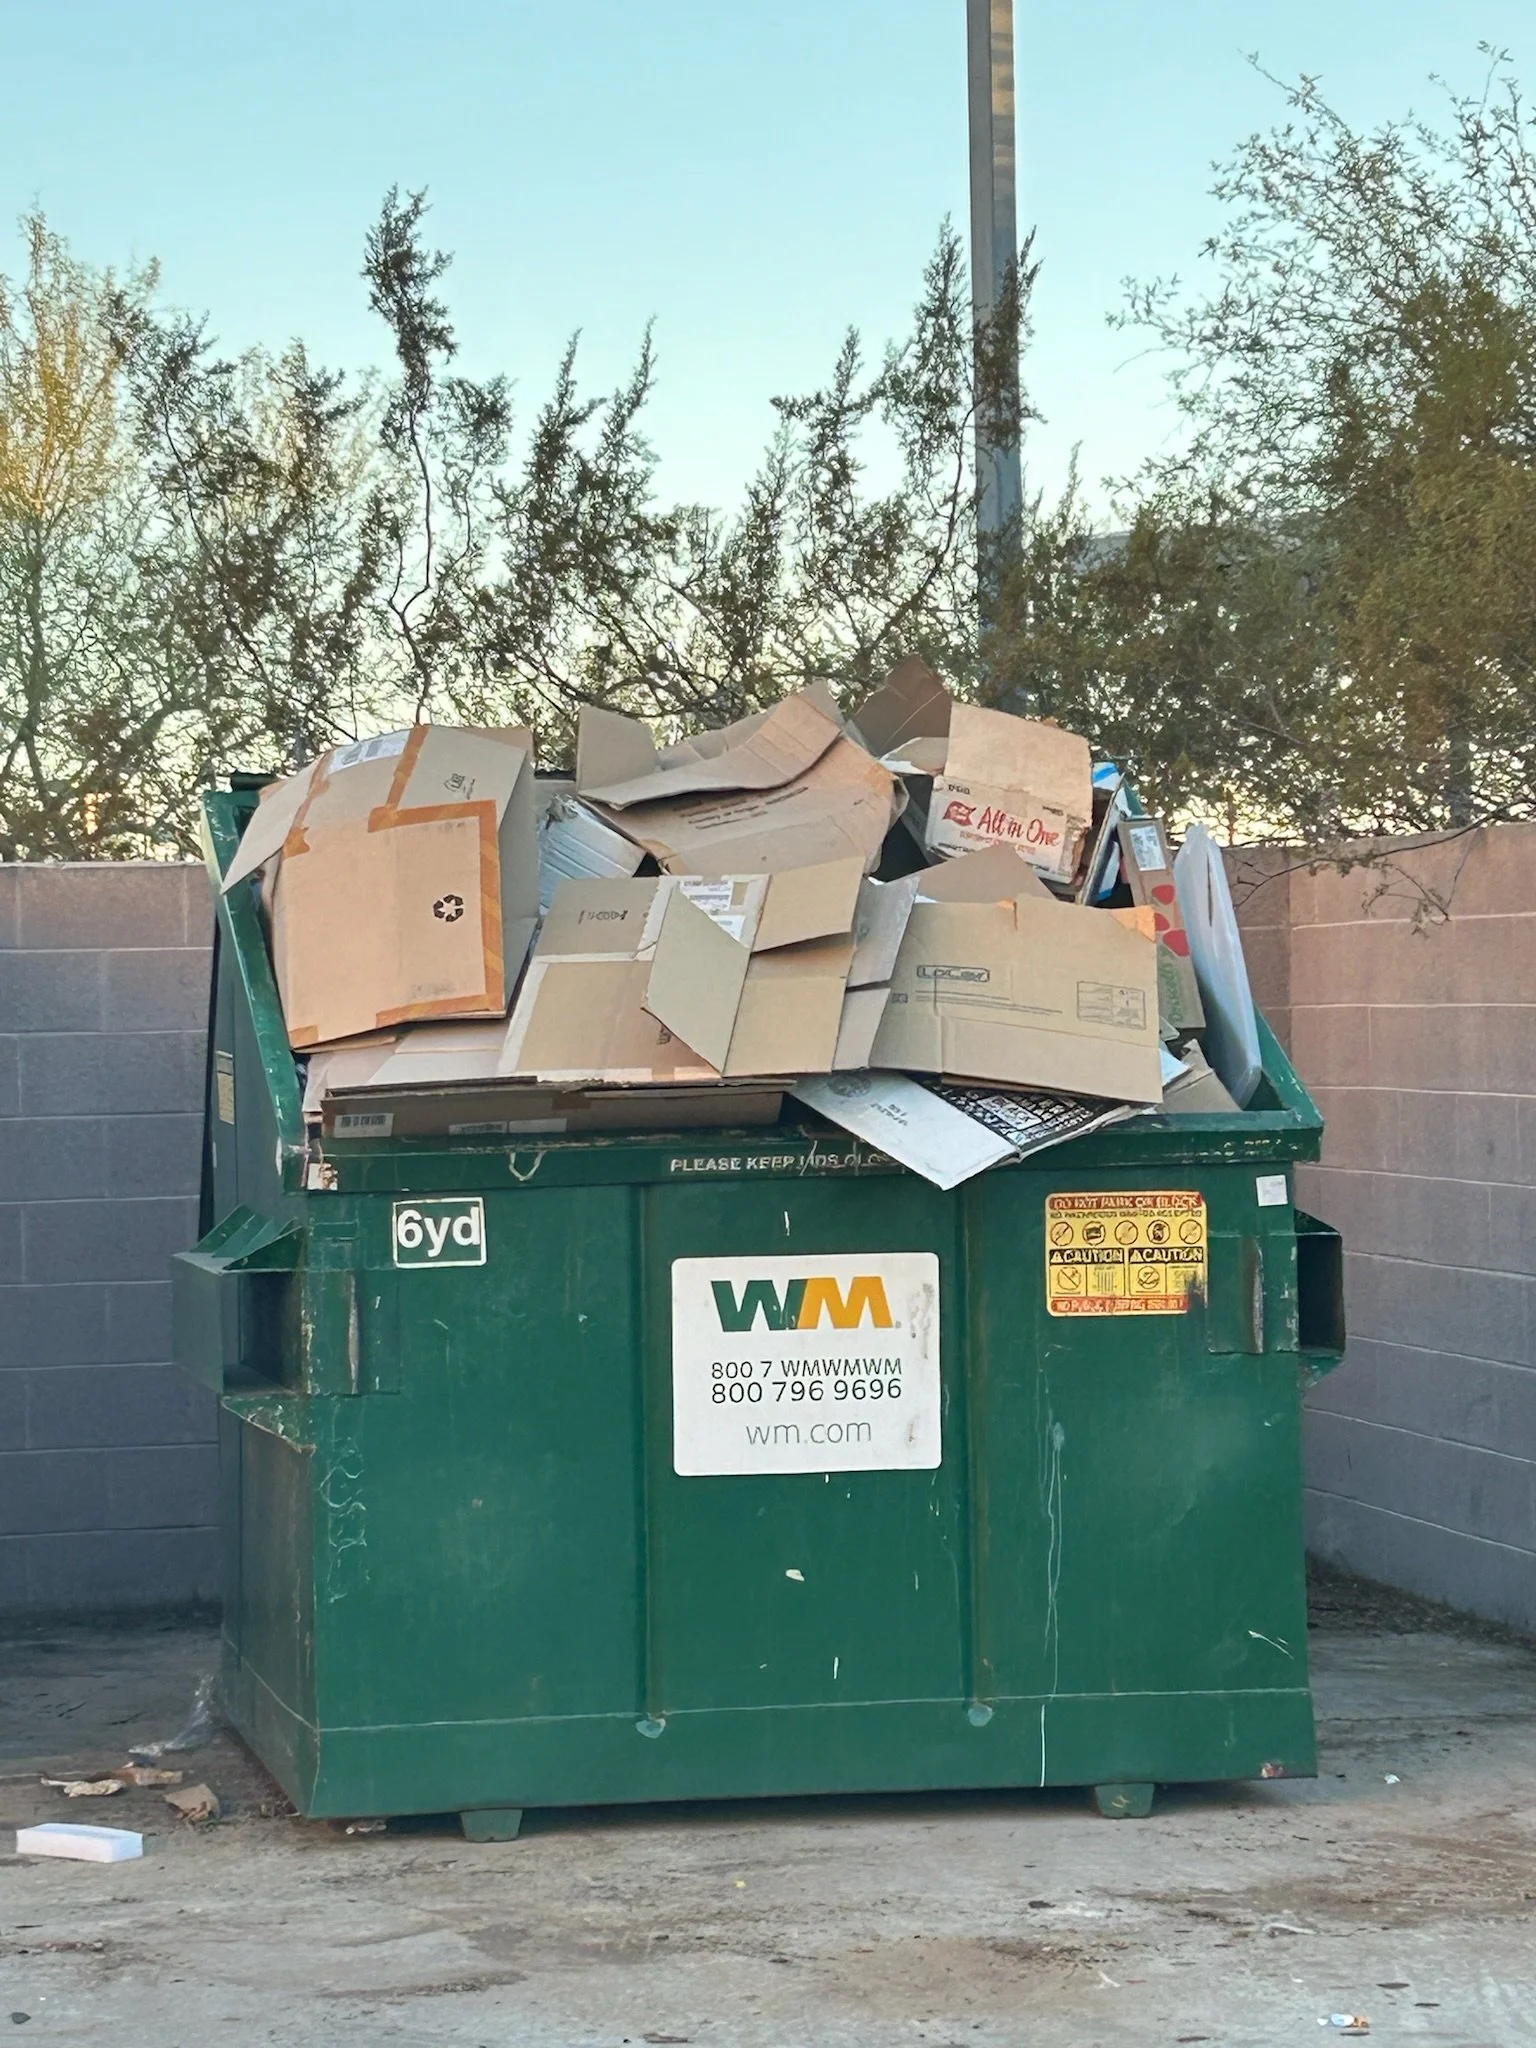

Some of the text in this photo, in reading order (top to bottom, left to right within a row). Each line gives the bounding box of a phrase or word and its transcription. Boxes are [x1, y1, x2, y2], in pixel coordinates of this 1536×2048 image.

[977, 806, 1006, 836] All
[1007, 817, 1024, 838] in
[1026, 818, 1060, 846] One
[670, 1157, 741, 1172] PLEASE
[747, 1155, 794, 1170] KEEP
[1100, 1196, 1133, 1208] PARK
[397, 1206, 481, 1258] 6yd
[1063, 1249, 1123, 1263] CAUTION
[1143, 1248, 1203, 1262] CAUTION
[711, 1276, 894, 1332] WM
[711, 1358, 902, 1379] 800 7 WMWMWM
[711, 1378, 902, 1403] 800 796 9696
[746, 1422, 871, 1445] wm.com
